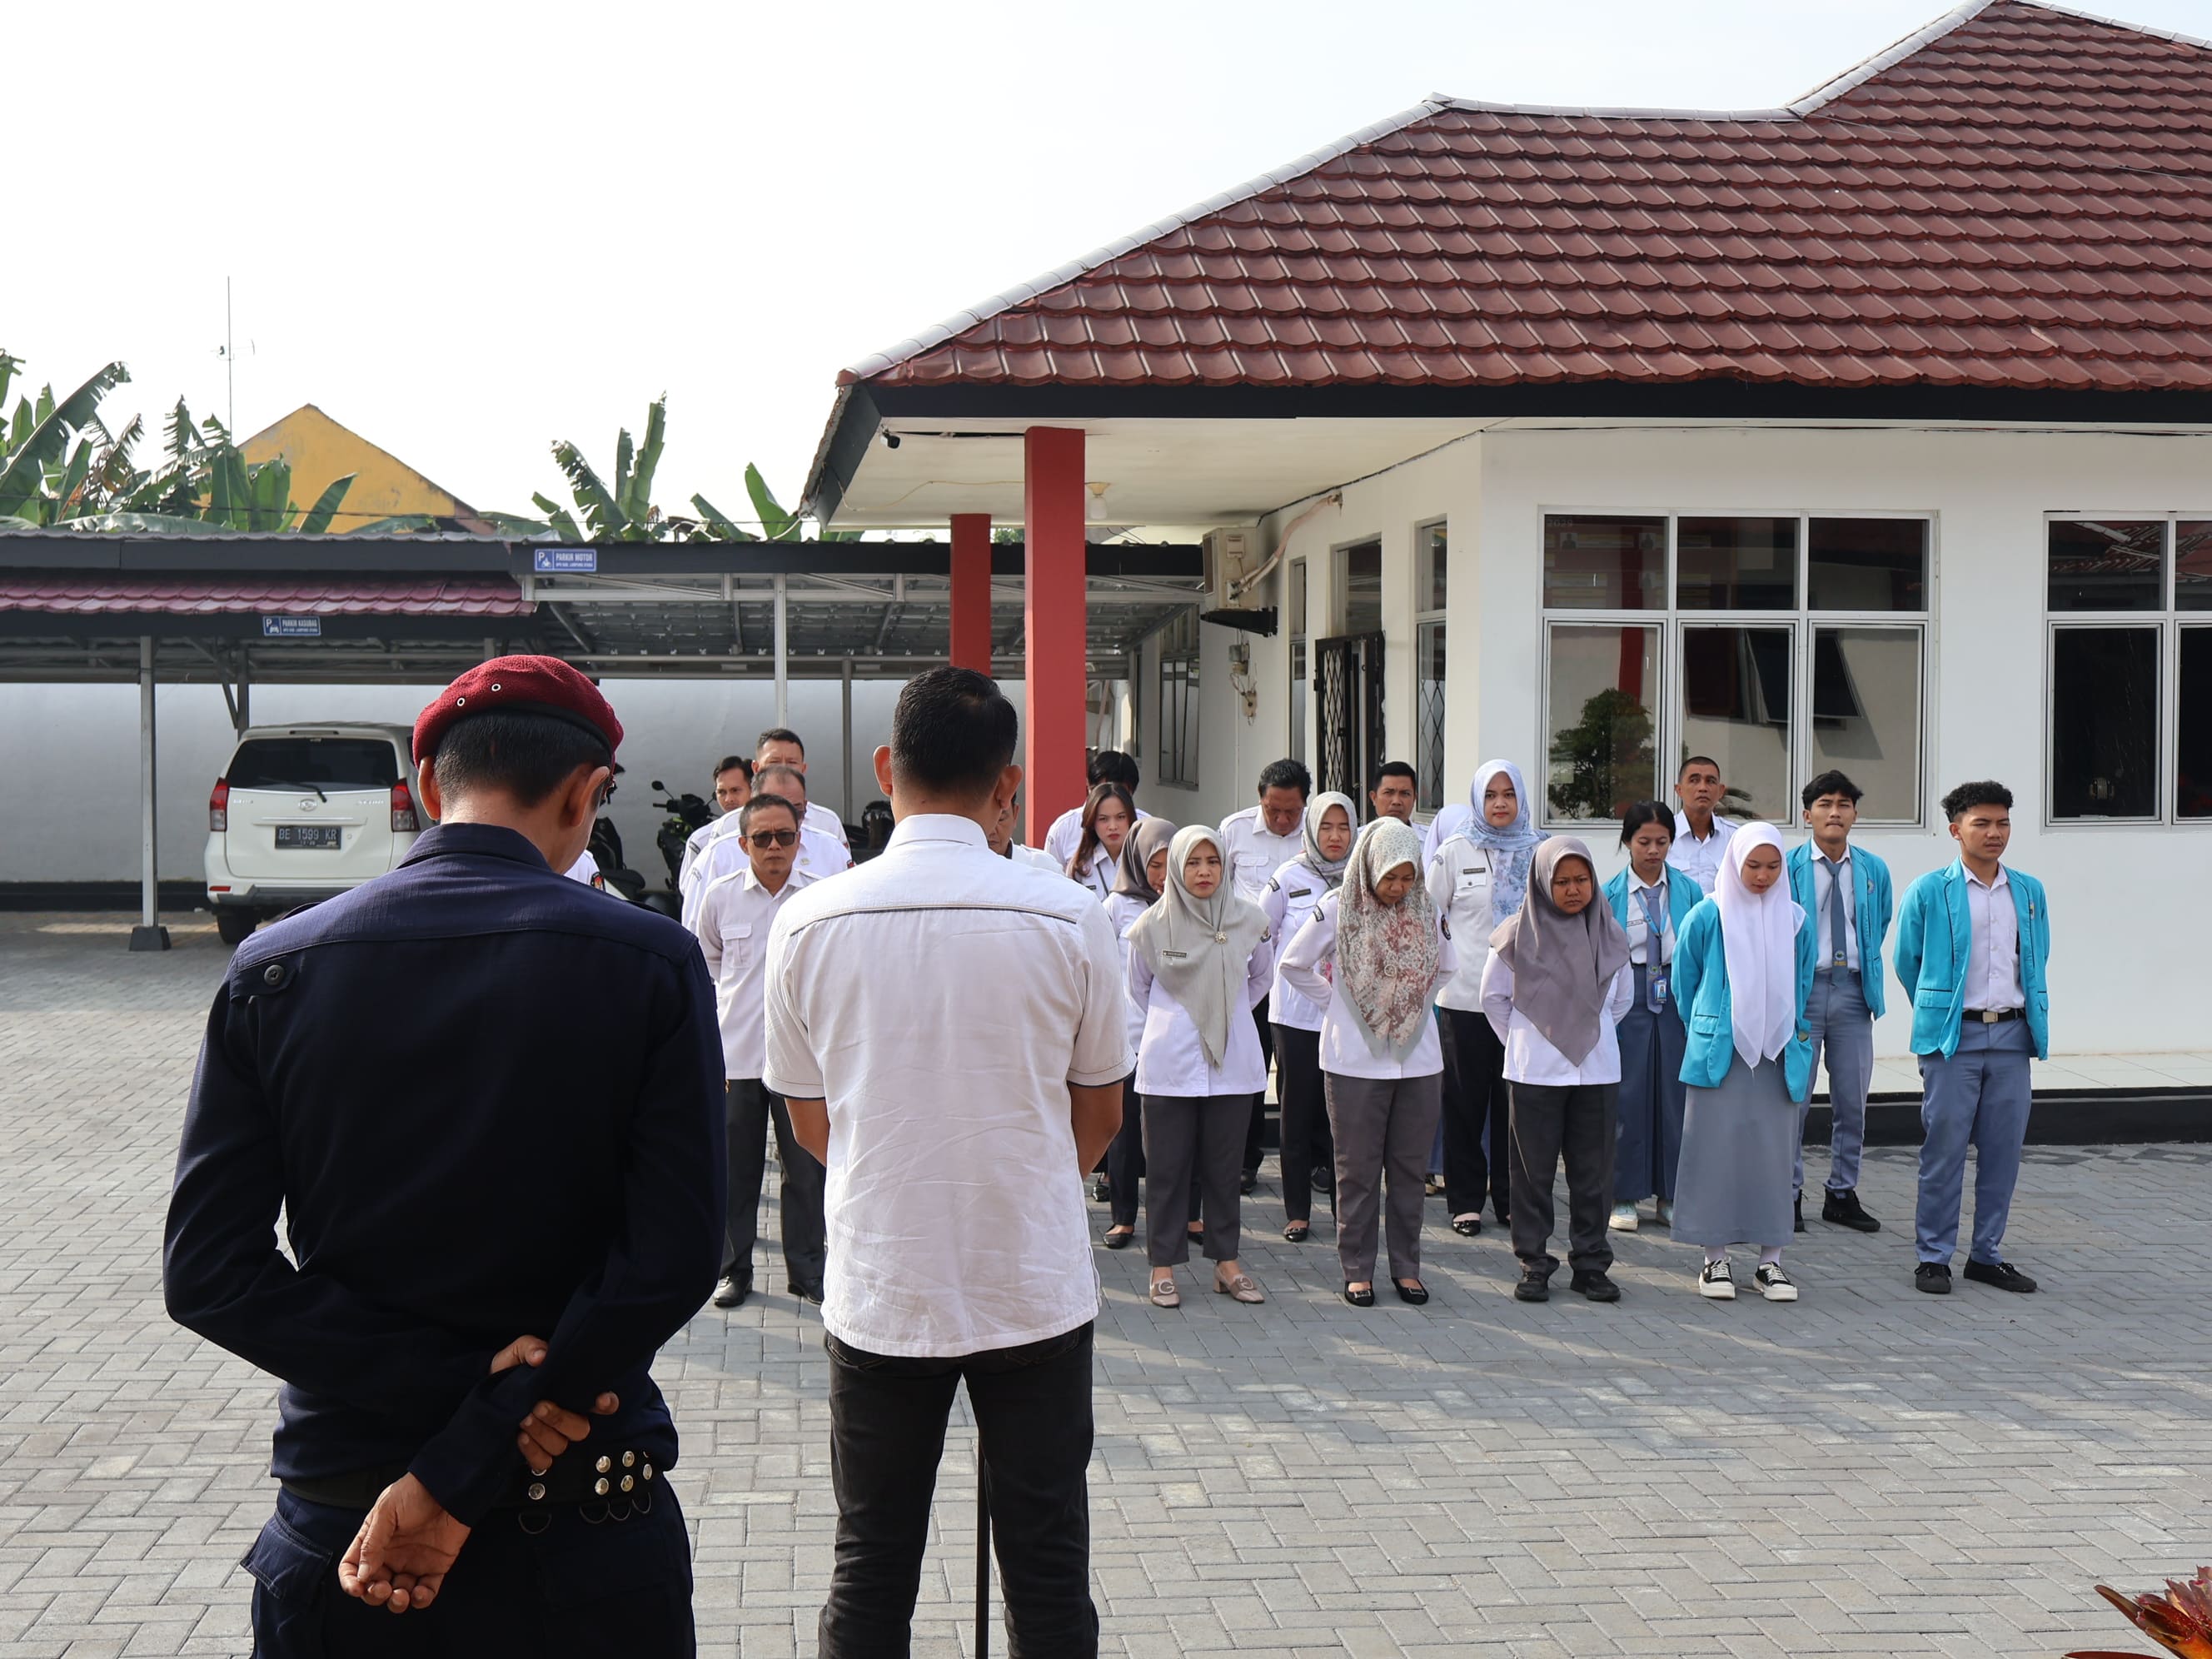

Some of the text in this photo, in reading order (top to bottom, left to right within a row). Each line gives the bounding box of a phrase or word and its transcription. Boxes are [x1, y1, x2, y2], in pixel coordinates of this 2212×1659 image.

[555, 553, 593, 561] PARKIR MOTOR
[278, 828, 337, 840] BE 1599 KR
